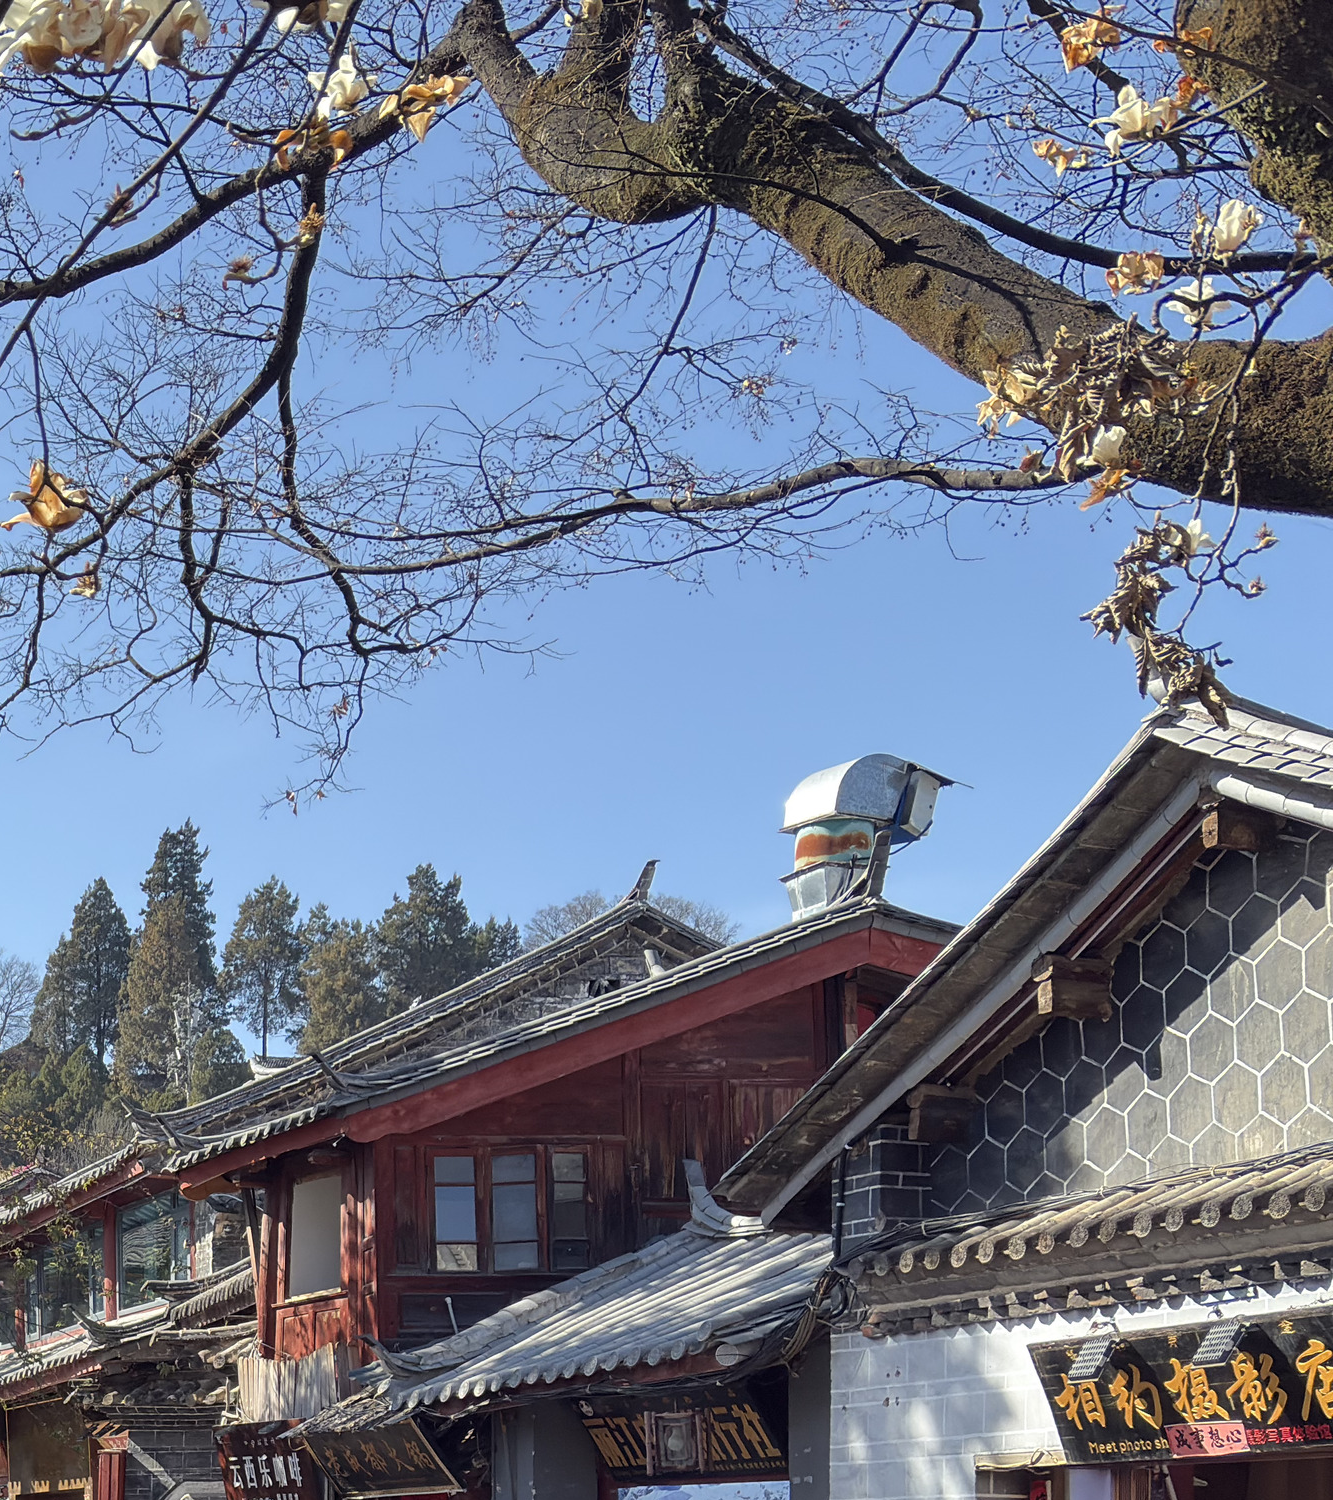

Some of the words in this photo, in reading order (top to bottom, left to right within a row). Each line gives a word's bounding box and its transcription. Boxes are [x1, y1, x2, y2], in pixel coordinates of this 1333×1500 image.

[1088, 1439, 1117, 1455] Meet
[1119, 1438, 1152, 1454] photo
[228, 1452, 302, 1489] 云西乐咖啡
